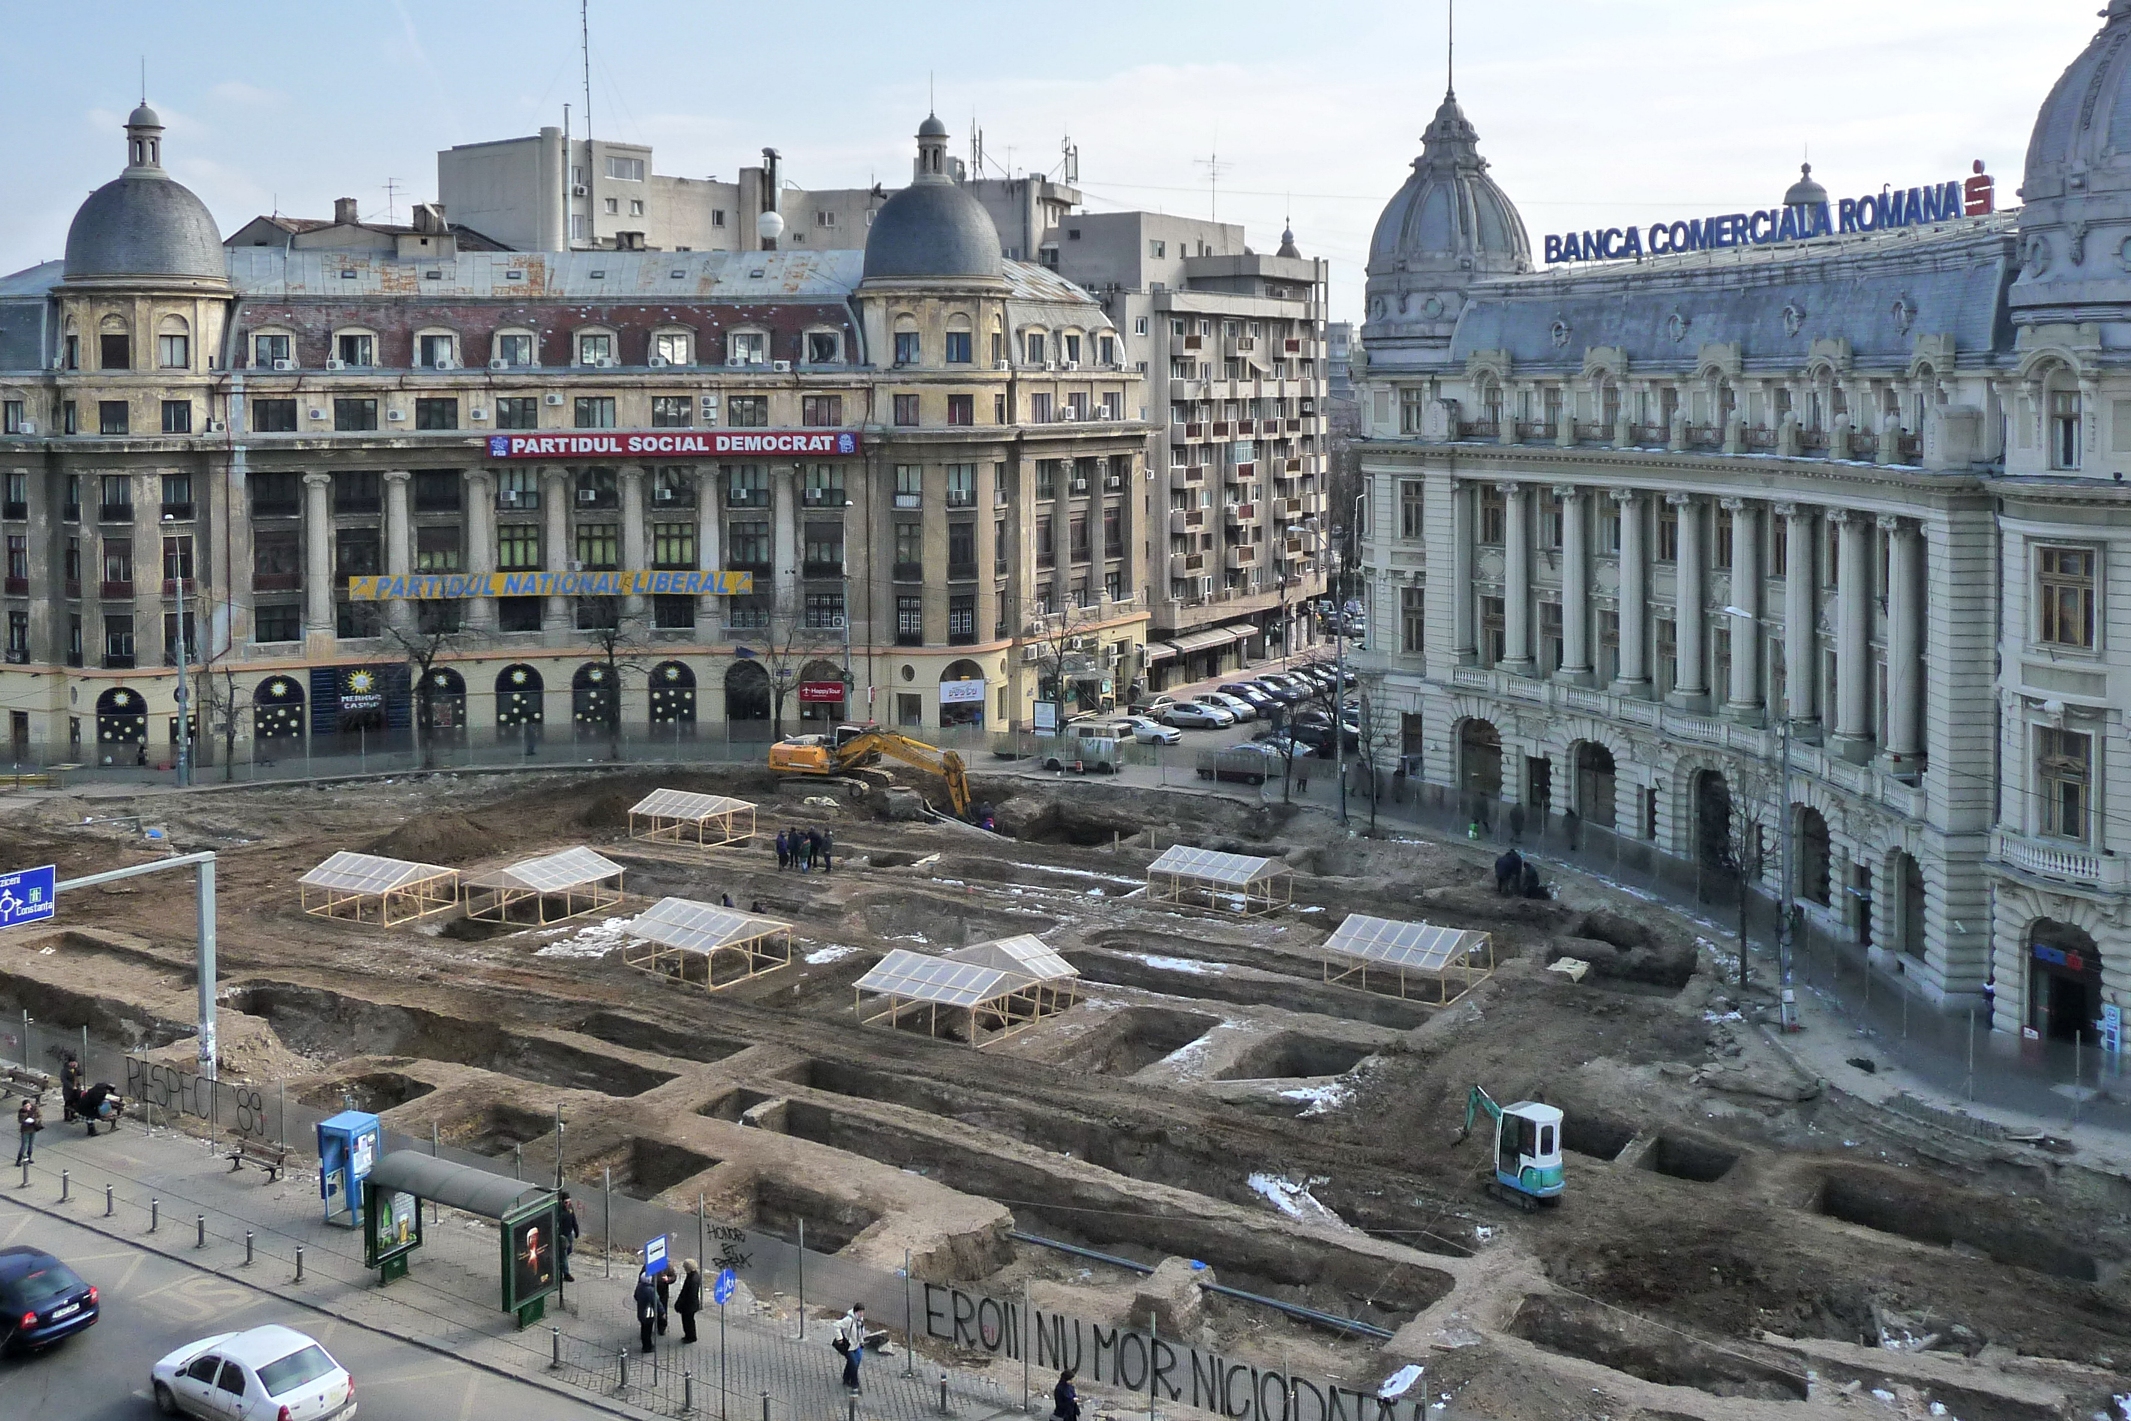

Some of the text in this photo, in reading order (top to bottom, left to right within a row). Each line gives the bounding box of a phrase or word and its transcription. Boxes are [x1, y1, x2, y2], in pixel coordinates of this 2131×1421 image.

[1545, 225, 1643, 264] BANCA
[1648, 203, 1835, 254] COMERCIALA
[1838, 180, 1966, 234] ROMANA
[512, 434, 835, 455] PARTIDUL SOCIAL DEMOCRAT
[374, 570, 730, 598] PARTIDUL NATIONAL LIBERAL
[126, 1056, 227, 1124] RESPECT
[721, 1242, 737, 1256] ET
[924, 1282, 1020, 1361] EROII
[1036, 1309, 1083, 1373] NU
[1093, 1322, 1182, 1399] MOR
